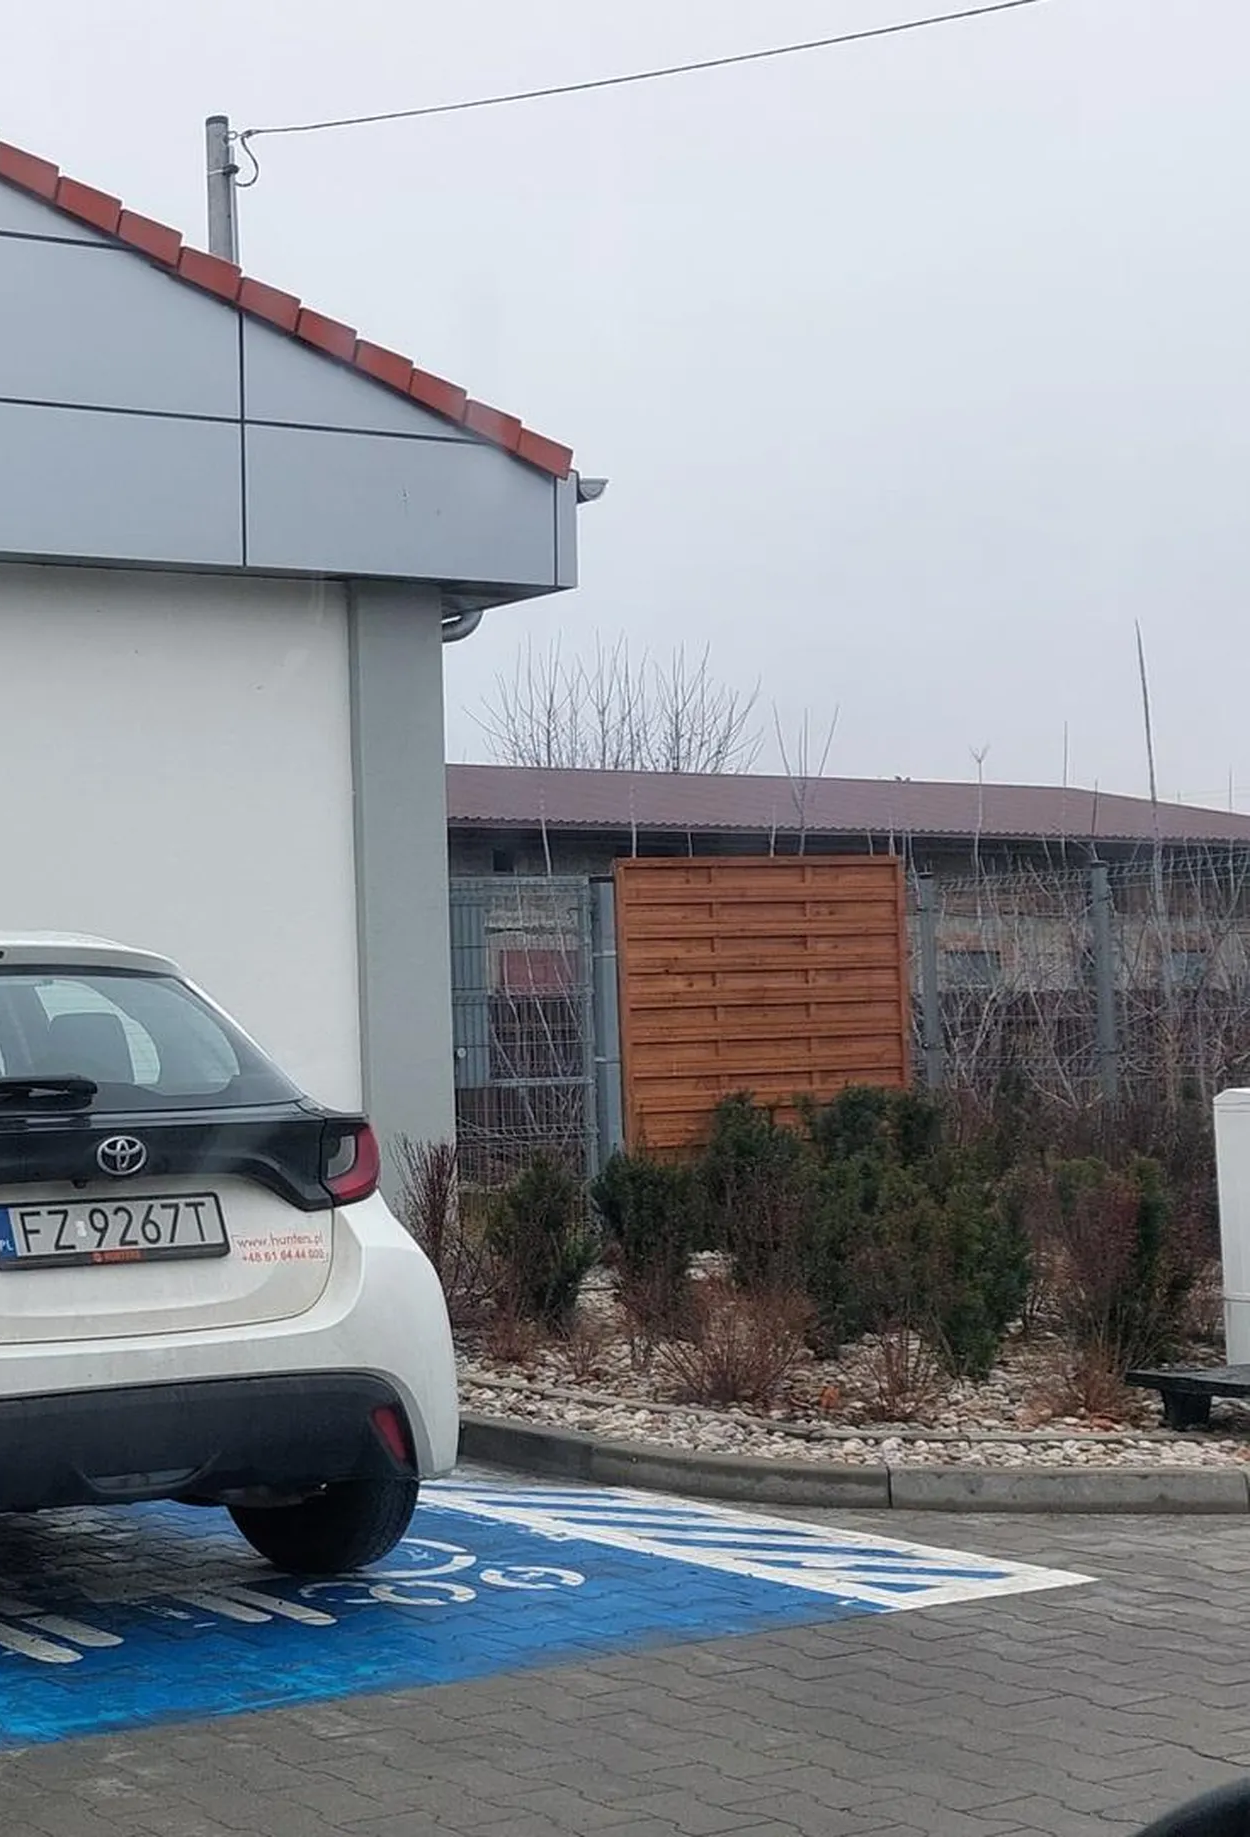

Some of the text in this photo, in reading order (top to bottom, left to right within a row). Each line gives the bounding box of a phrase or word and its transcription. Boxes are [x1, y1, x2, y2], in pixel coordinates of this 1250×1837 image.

[19, 1202, 206, 1252] FZ 9267T
[237, 1230, 324, 1248] www.hunters.pl
